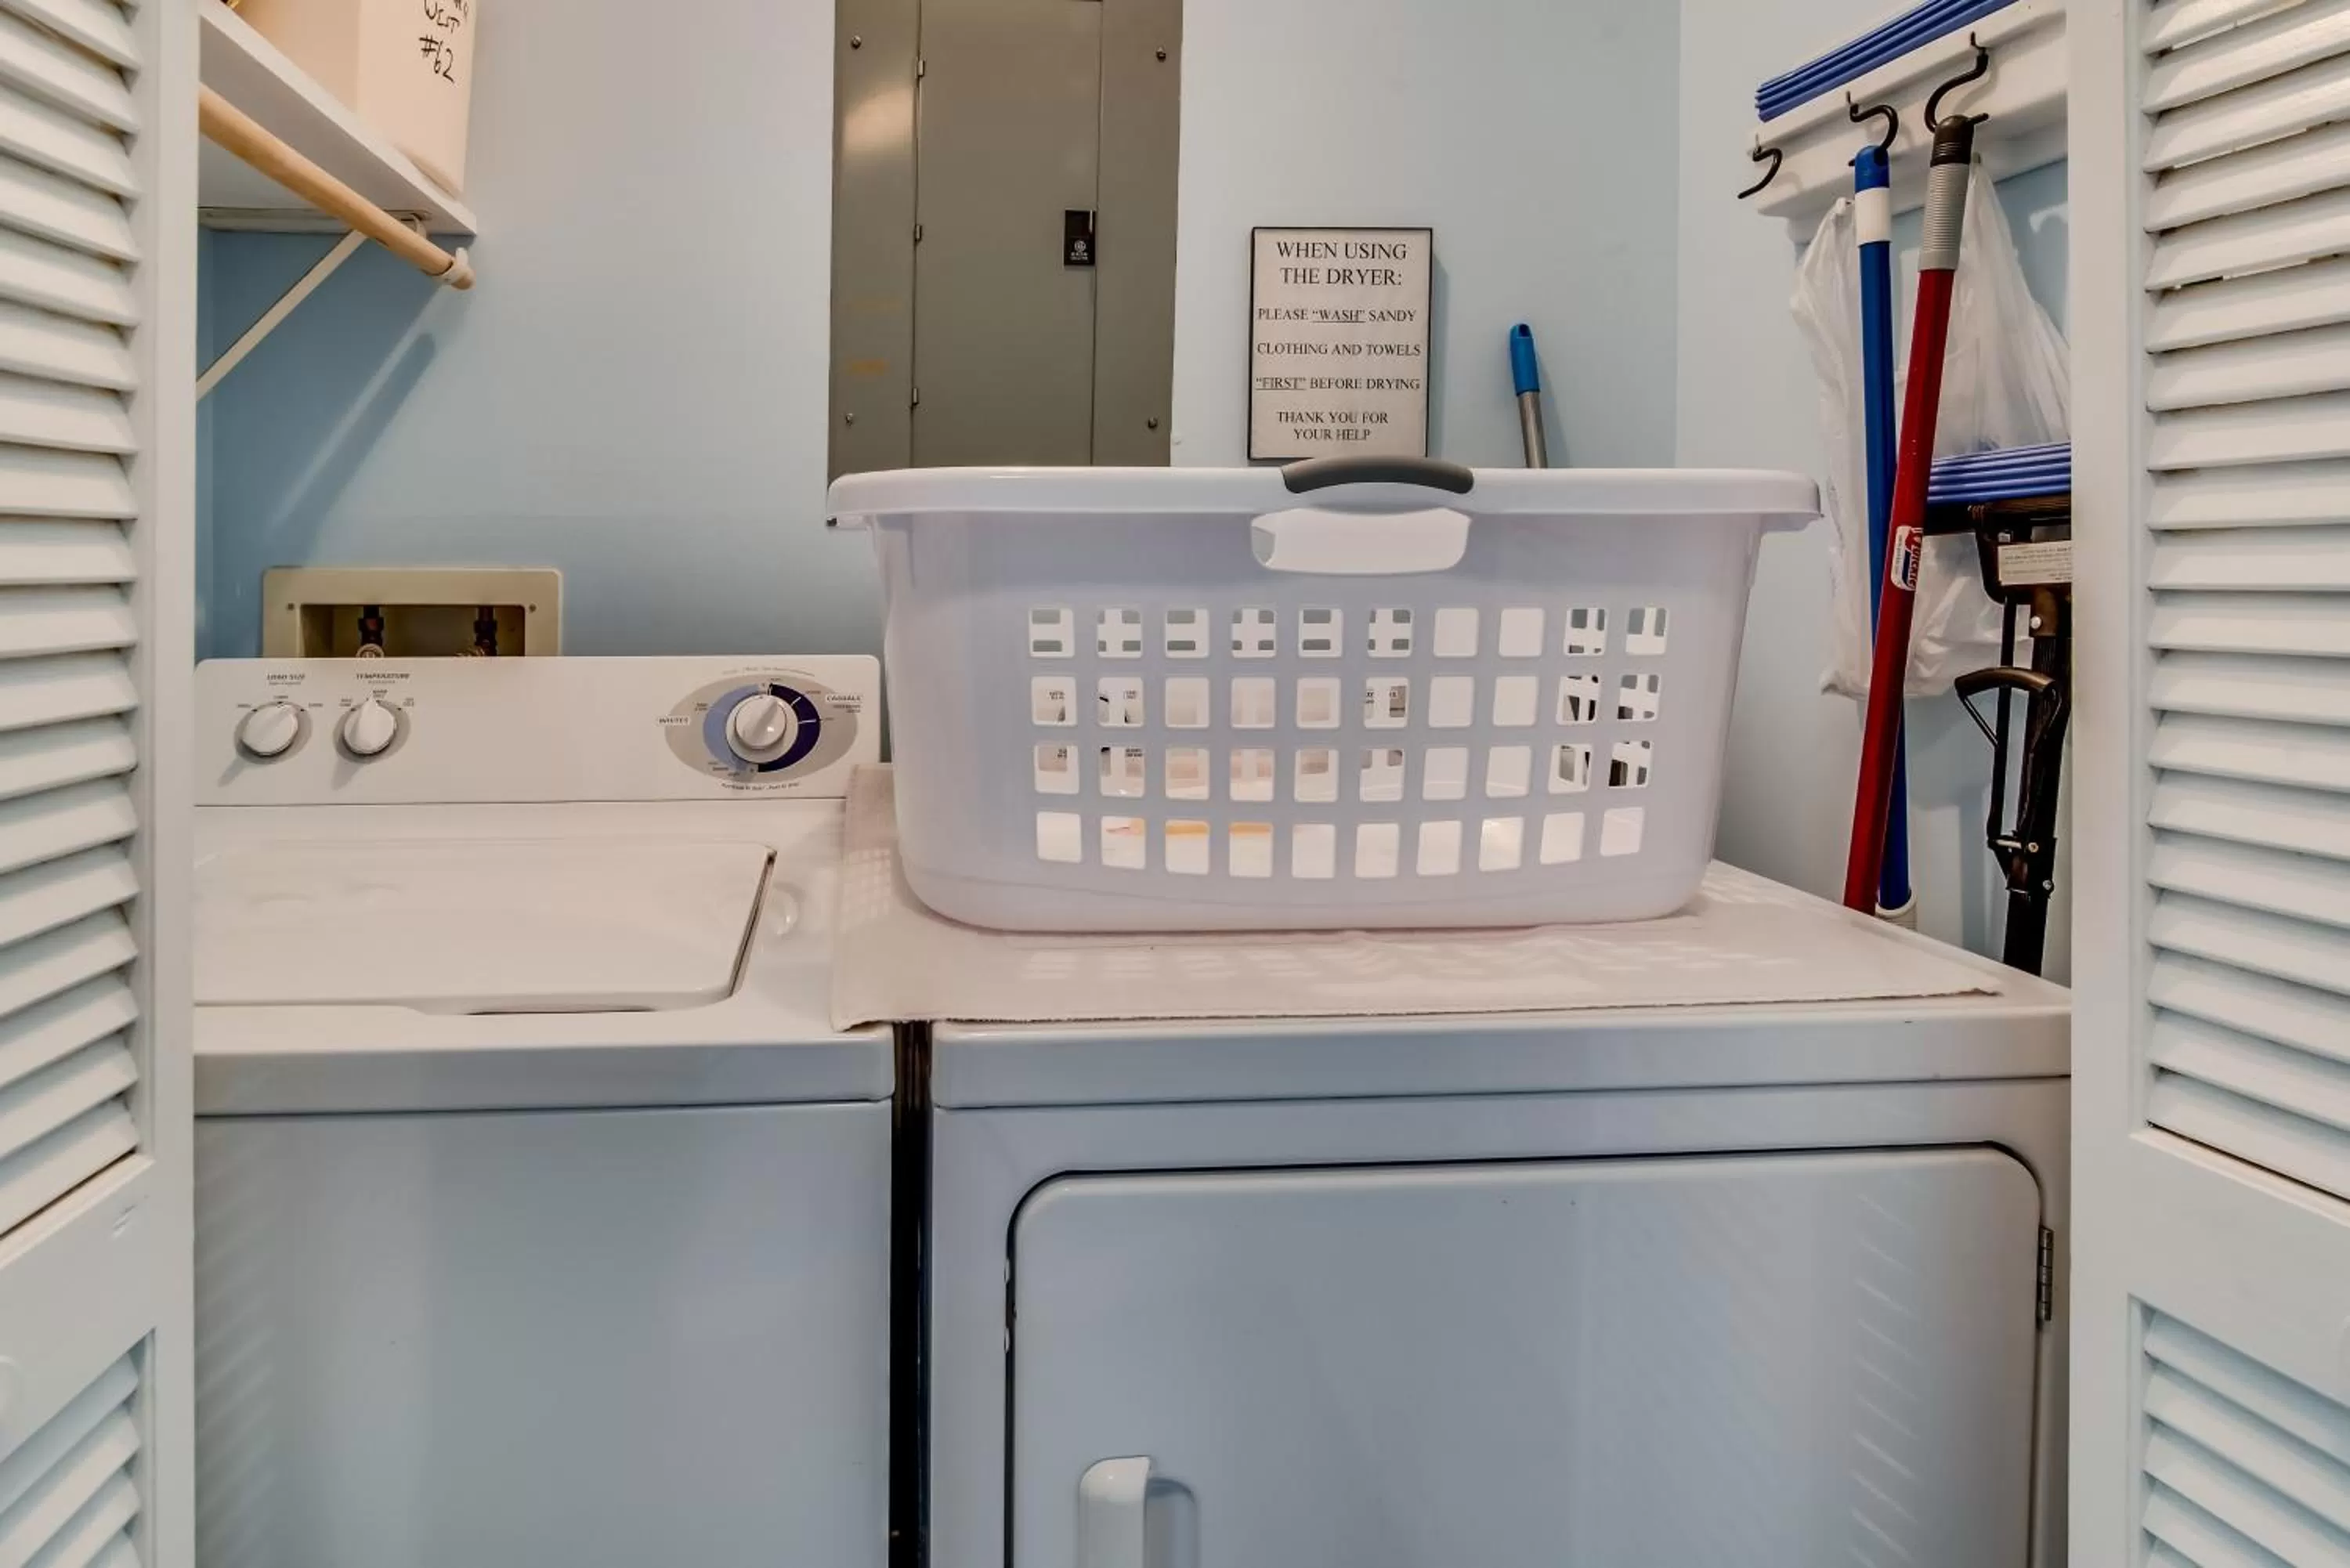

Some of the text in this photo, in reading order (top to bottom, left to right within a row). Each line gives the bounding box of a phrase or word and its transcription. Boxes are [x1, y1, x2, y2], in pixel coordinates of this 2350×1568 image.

[1277, 241, 1408, 259] WHEN USING
[1280, 267, 1402, 286] THE DRYER:
[1257, 308, 1308, 320] PLEASE
[1368, 309, 1416, 322] SANDY
[1257, 342, 1422, 356] CLOTHING AND TOWELS
[1310, 377, 1362, 389] BEFORE
[1365, 378, 1421, 390] DRYING
[1277, 411, 1389, 424] THANK YOU FOR
[1293, 428, 1371, 441] YOUR HELP
